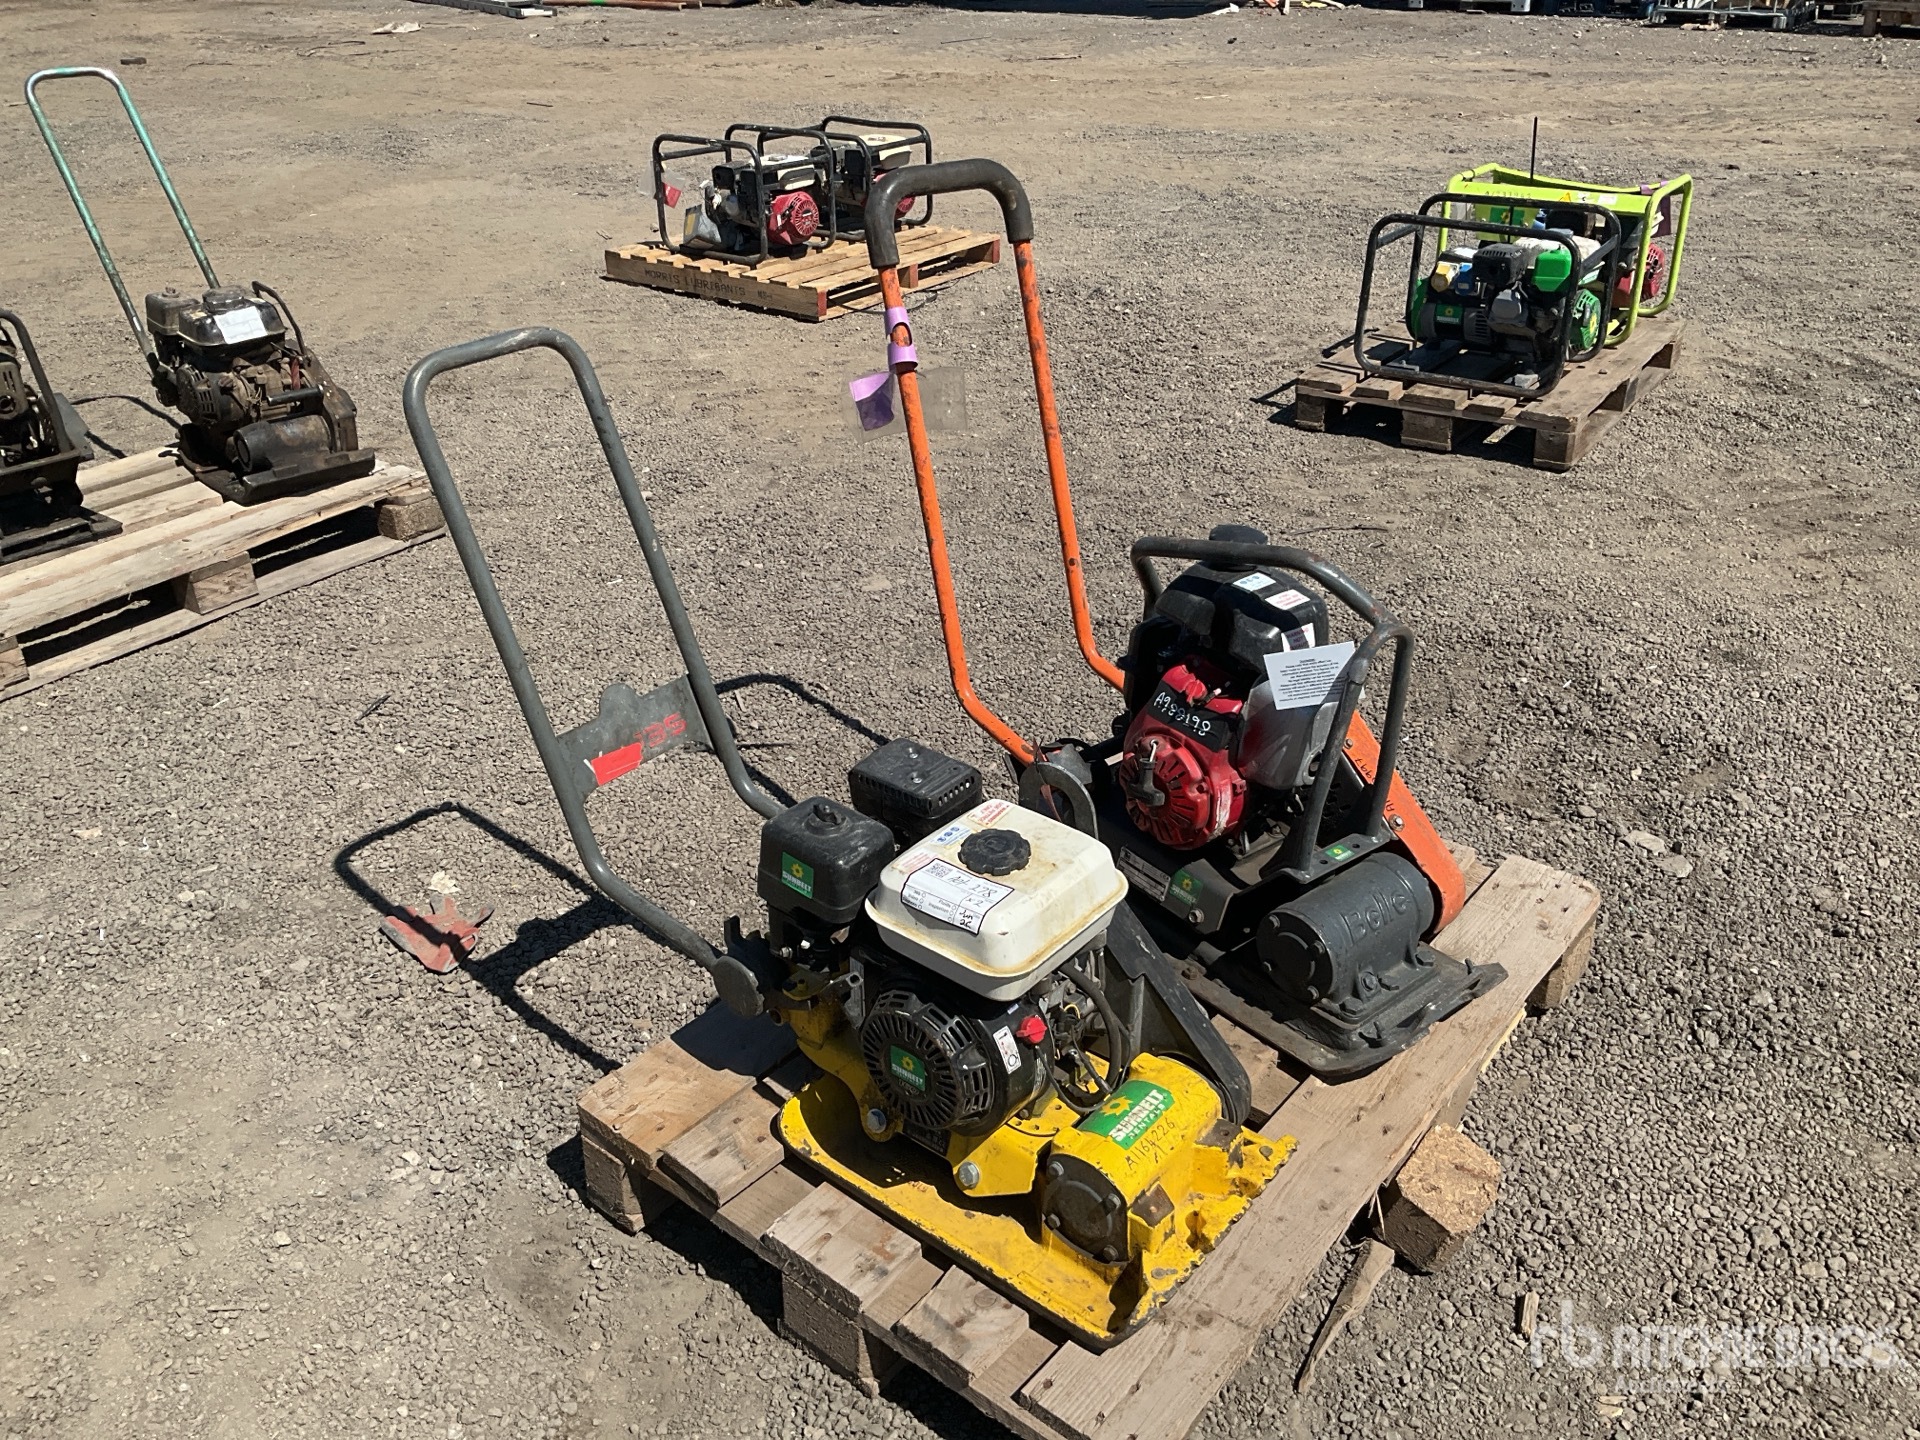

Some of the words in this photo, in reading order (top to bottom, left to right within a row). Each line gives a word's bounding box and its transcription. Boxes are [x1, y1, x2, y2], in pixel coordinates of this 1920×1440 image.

[644, 269, 680, 284] MORRIS
[1339, 889, 1410, 946] Belle
[1125, 1117, 1176, 1171] A1164226
